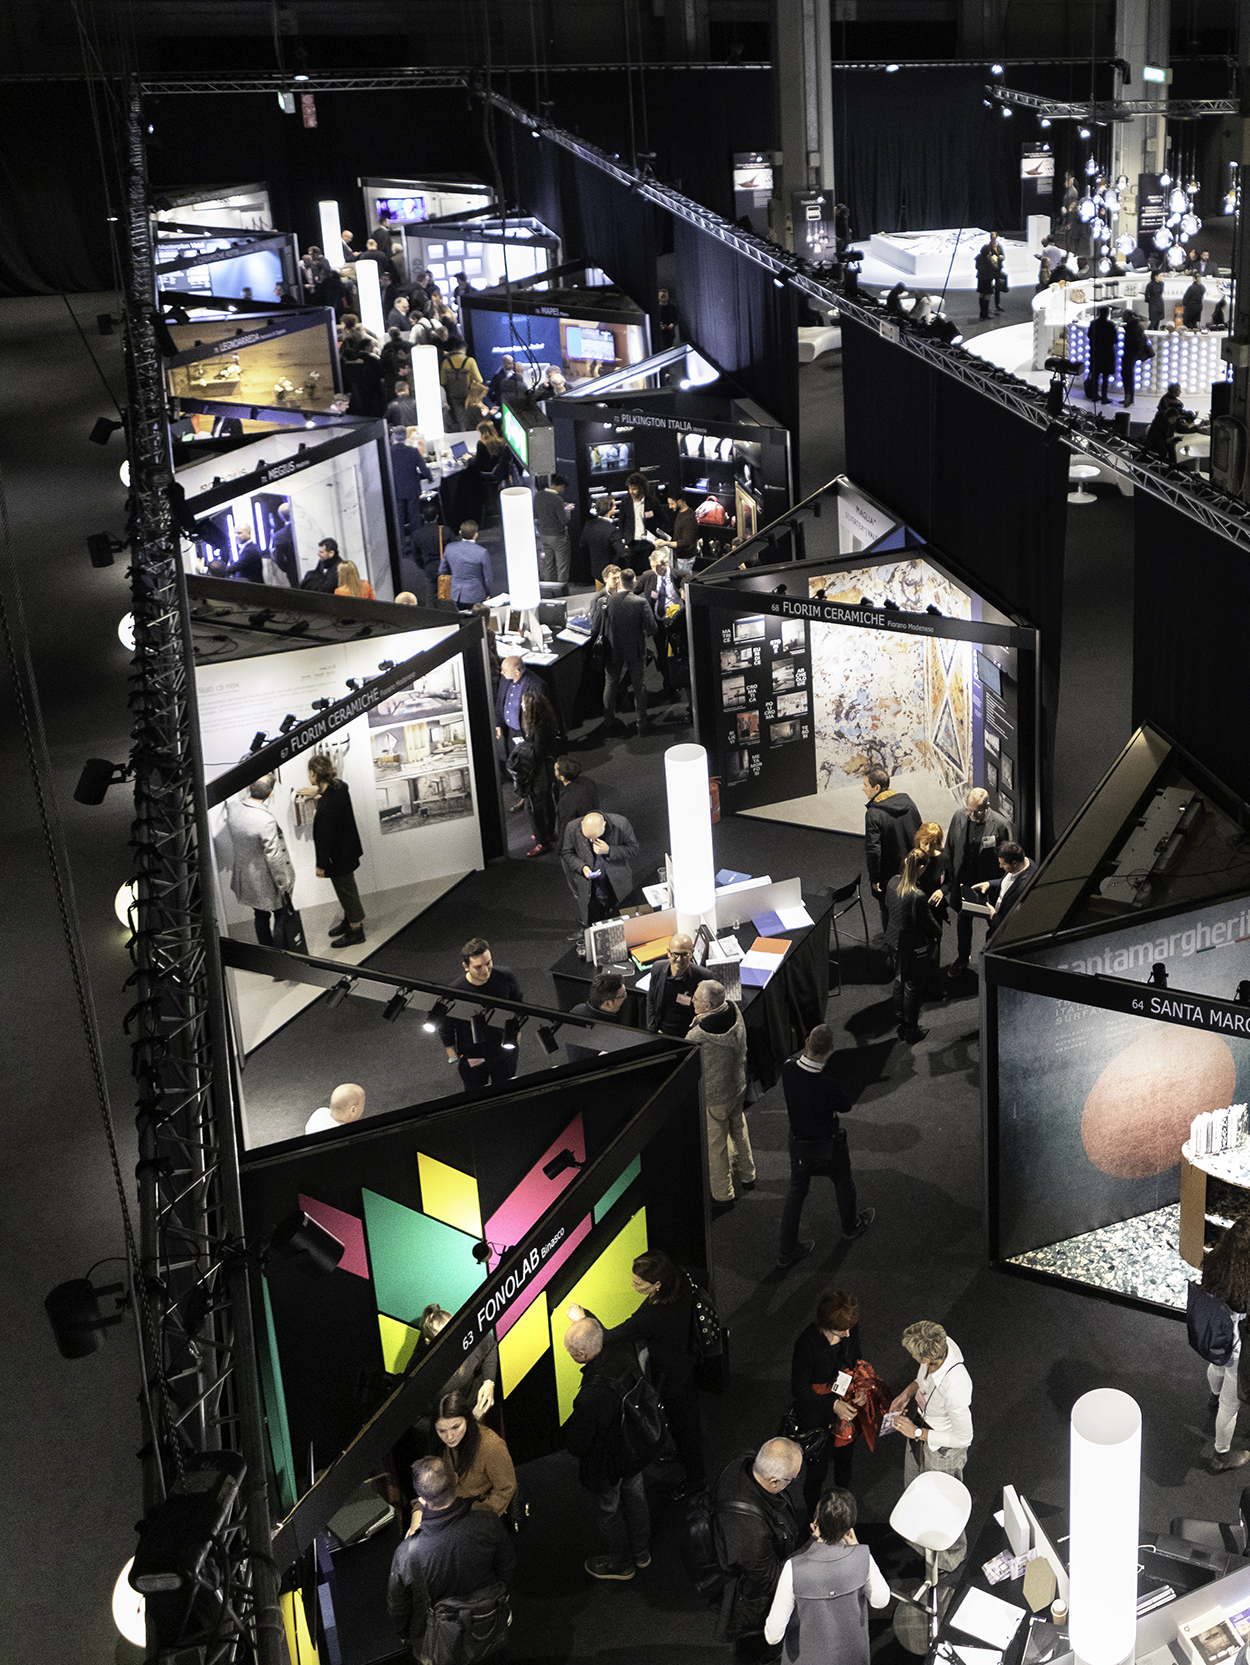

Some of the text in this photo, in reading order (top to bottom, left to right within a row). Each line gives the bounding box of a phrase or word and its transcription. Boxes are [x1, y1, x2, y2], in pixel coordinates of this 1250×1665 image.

[621, 413, 666, 428] PILKINGTON
[667, 420, 693, 431] ITALIA
[771, 601, 935, 633] 68 FLORIM CERAMICHE Fiorano Modenese
[280, 748, 289, 759] 67
[290, 719, 326, 752] FLORIM
[327, 687, 380, 729] CERAMICHE
[1131, 999, 1144, 1010] 64
[1150, 997, 1204, 1023] SANTA
[462, 1227, 565, 1351] 63 FONOLAB Binasco
